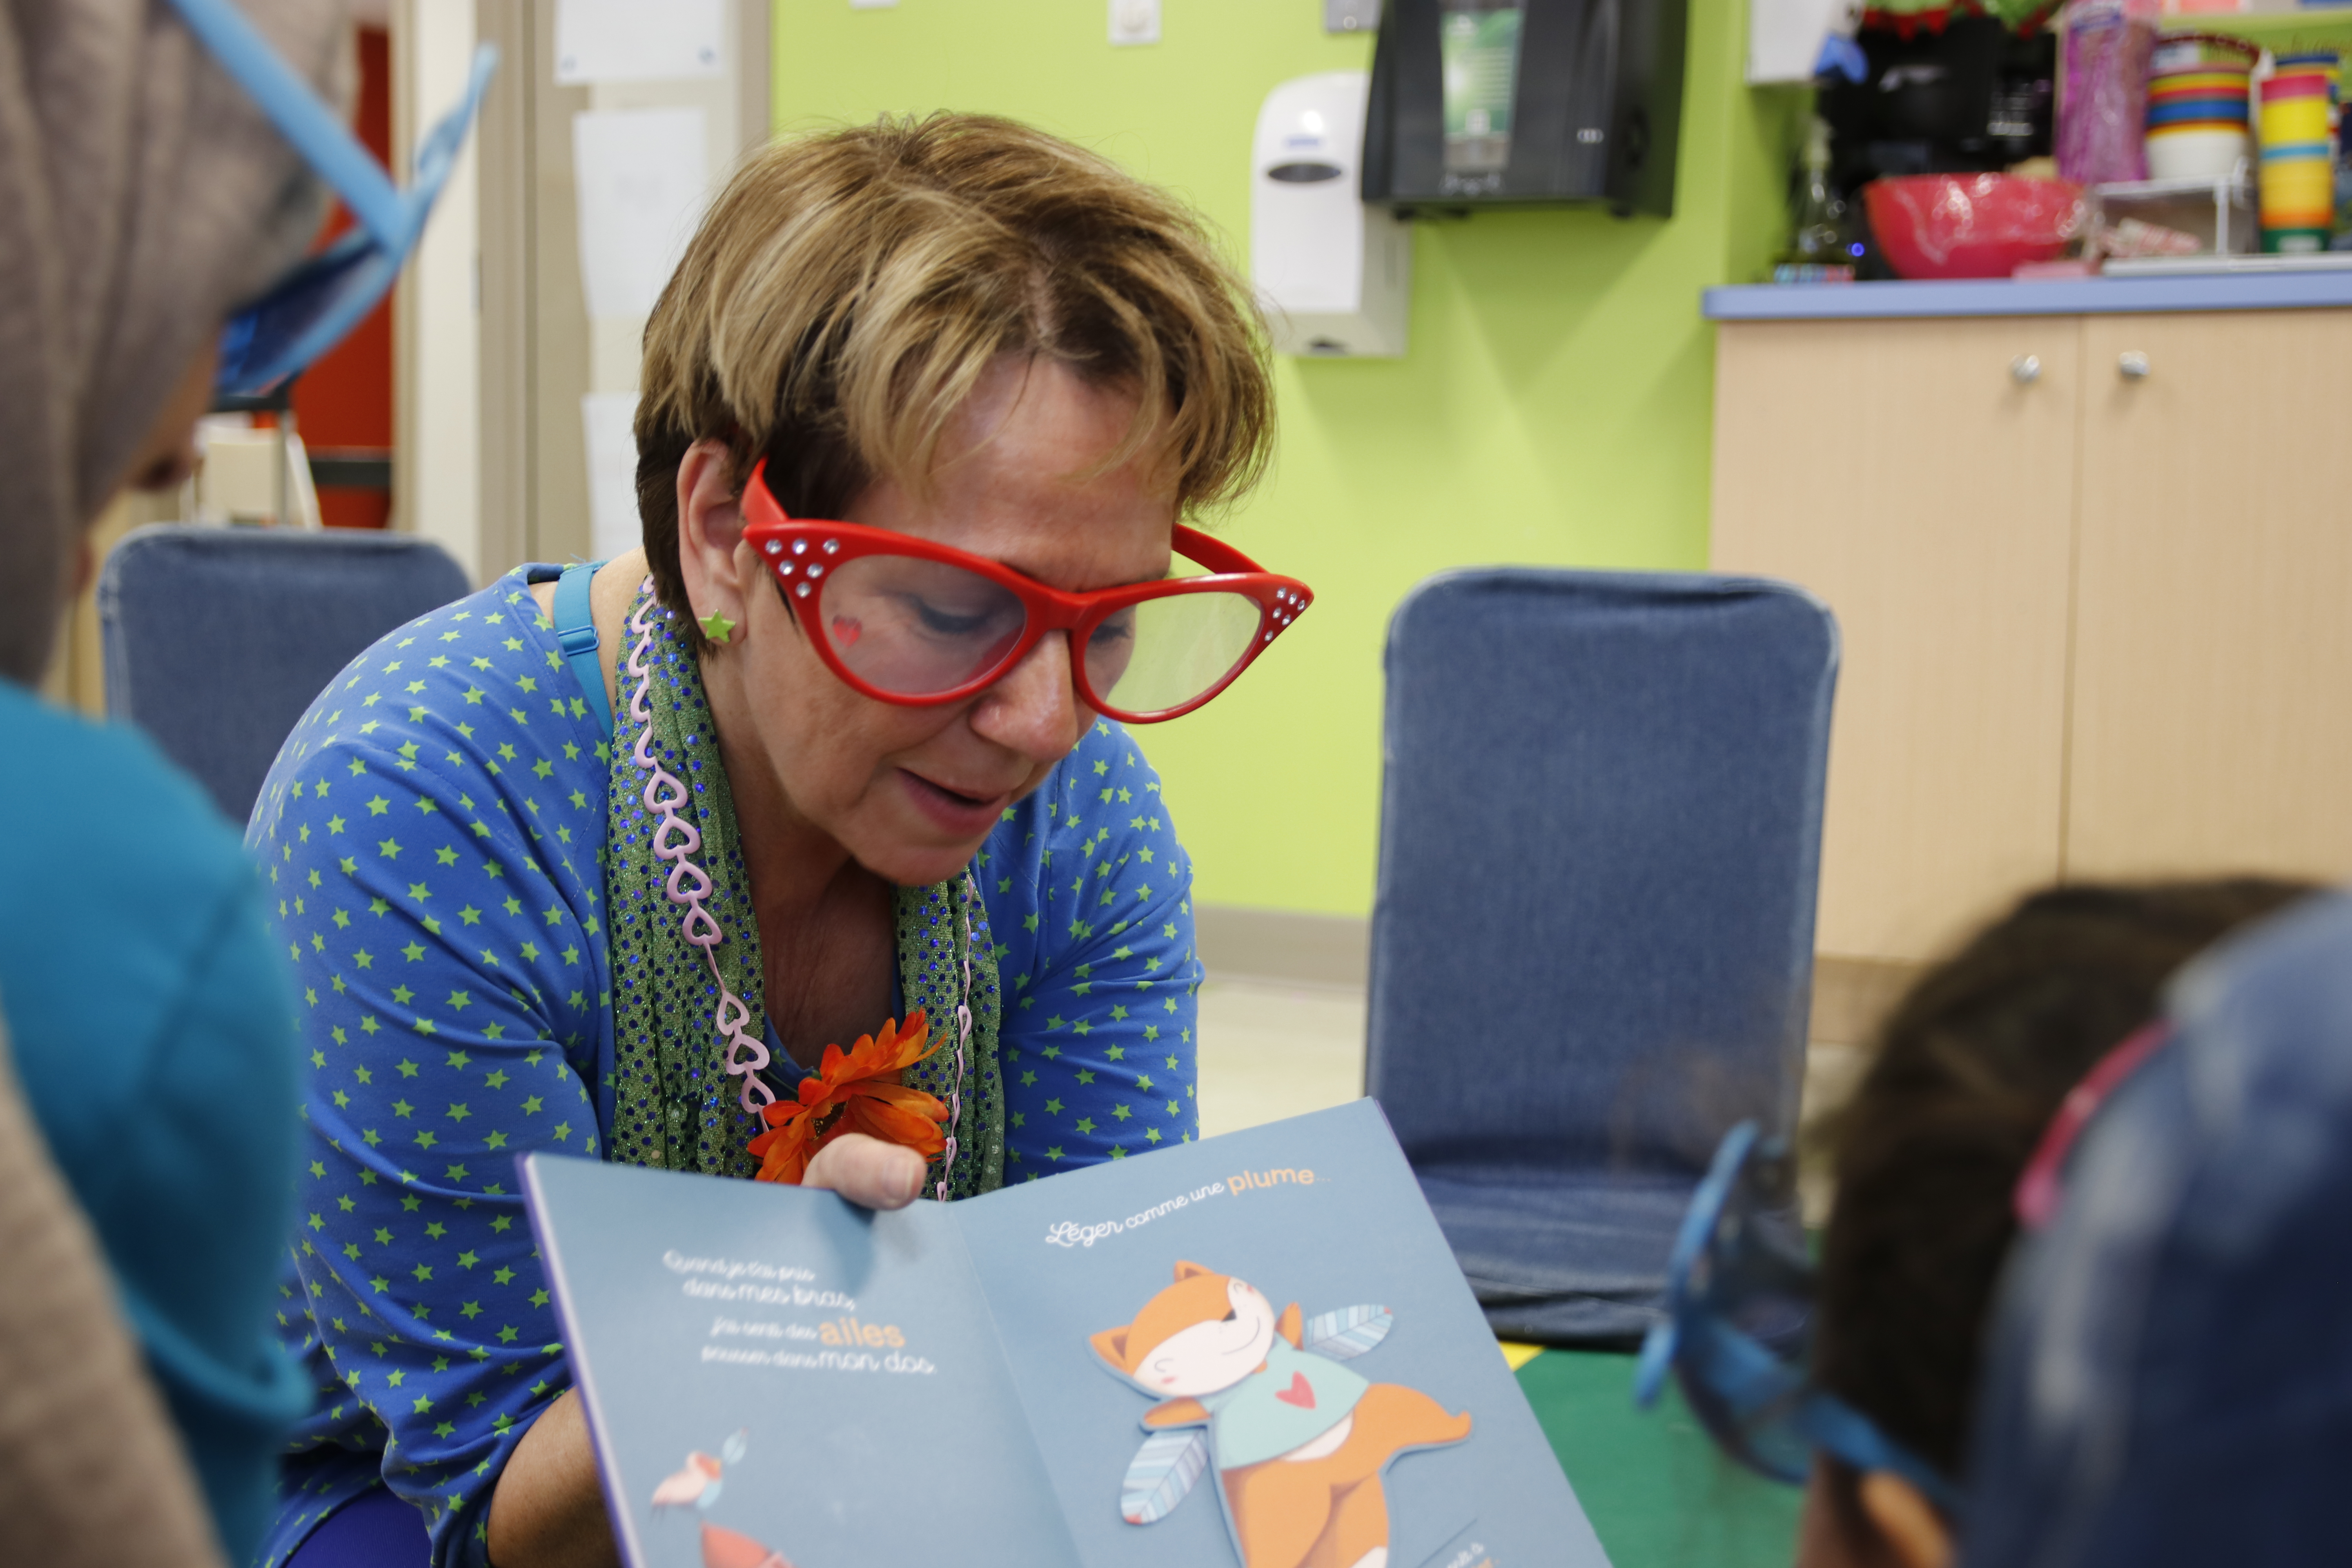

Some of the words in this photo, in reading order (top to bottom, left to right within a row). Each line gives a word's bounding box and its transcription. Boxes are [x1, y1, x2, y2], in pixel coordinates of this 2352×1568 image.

[1045, 1220, 1123, 1247] Léger
[1125, 1195, 1188, 1229] comme
[1190, 1182, 1225, 1201] une
[682, 1277, 737, 1300] dans
[739, 1284, 790, 1304] mes
[819, 1317, 906, 1348] ailes
[819, 1351, 880, 1371] mon
